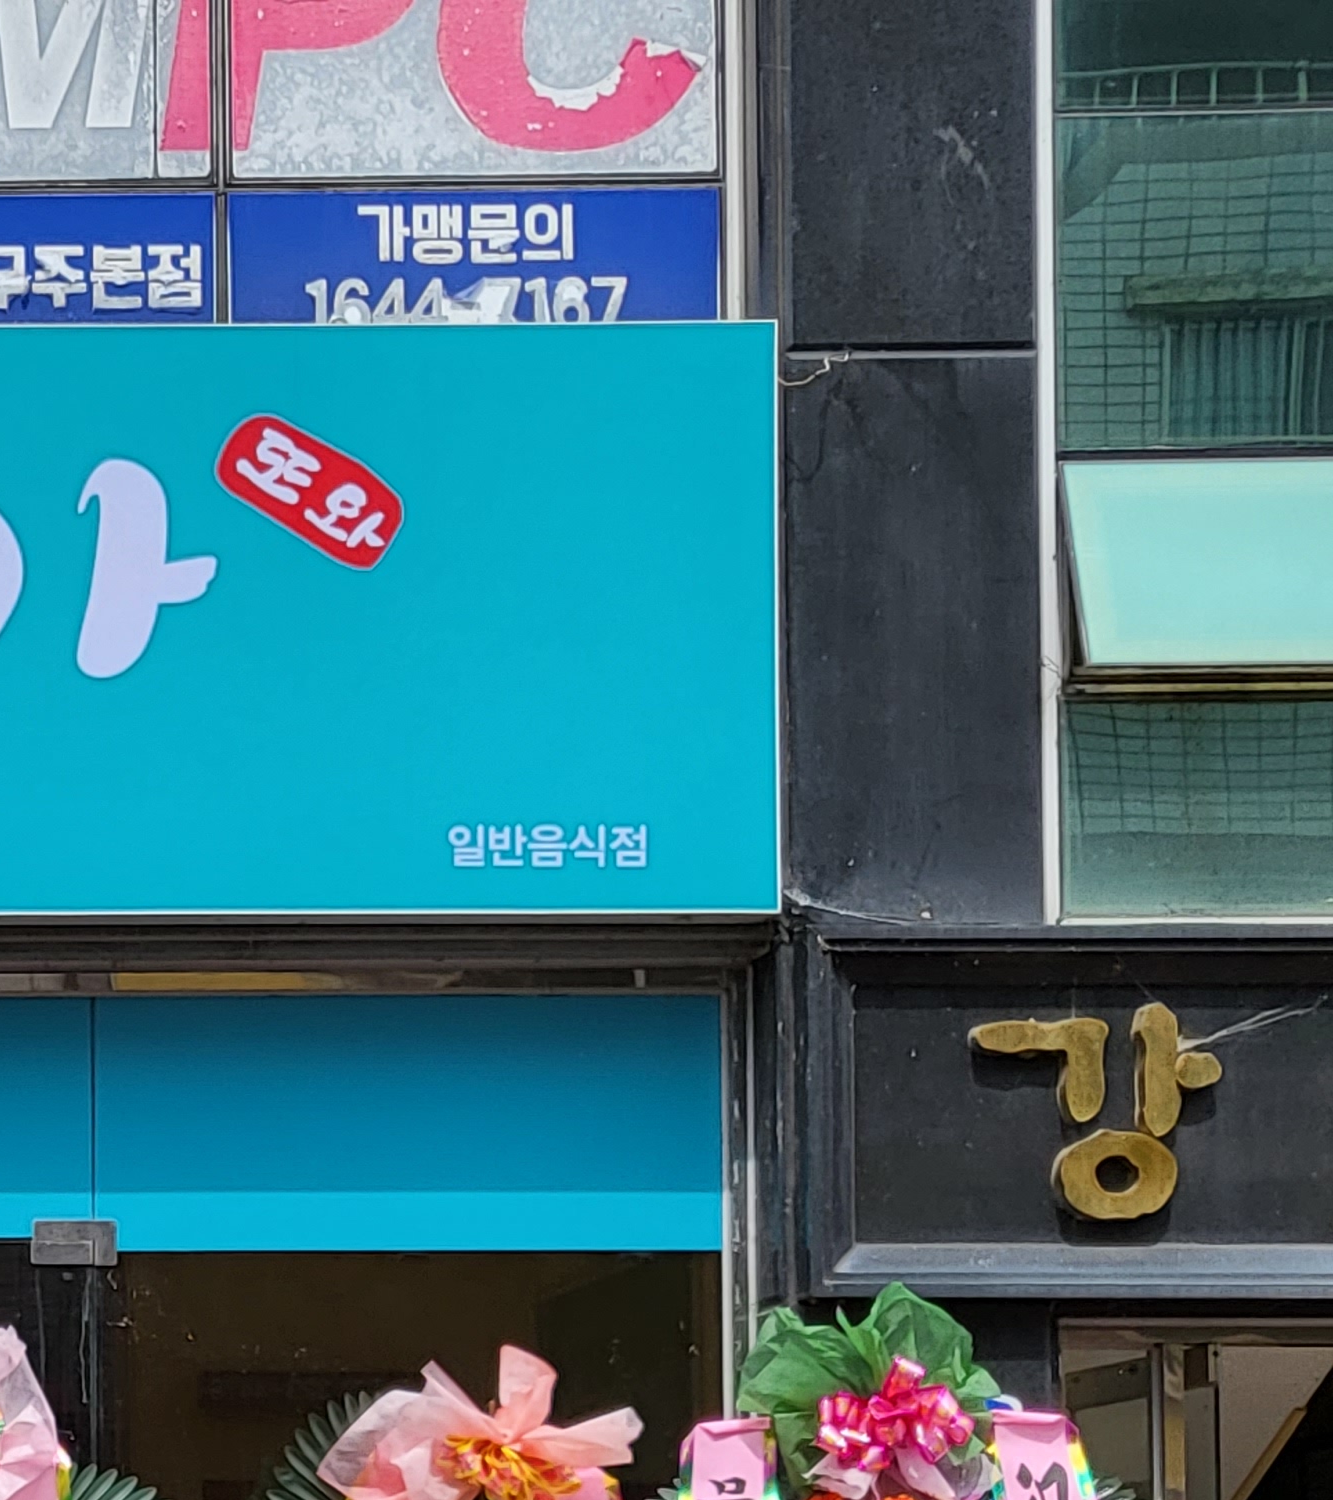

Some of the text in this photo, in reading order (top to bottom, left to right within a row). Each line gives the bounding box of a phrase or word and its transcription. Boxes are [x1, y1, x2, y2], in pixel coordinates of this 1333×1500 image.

[159, 0, 707, 153] PC
[357, 203, 574, 265] 가맹문의
[448, 824, 650, 868] 일반음식점
[968, 1002, 1222, 1219] 강
